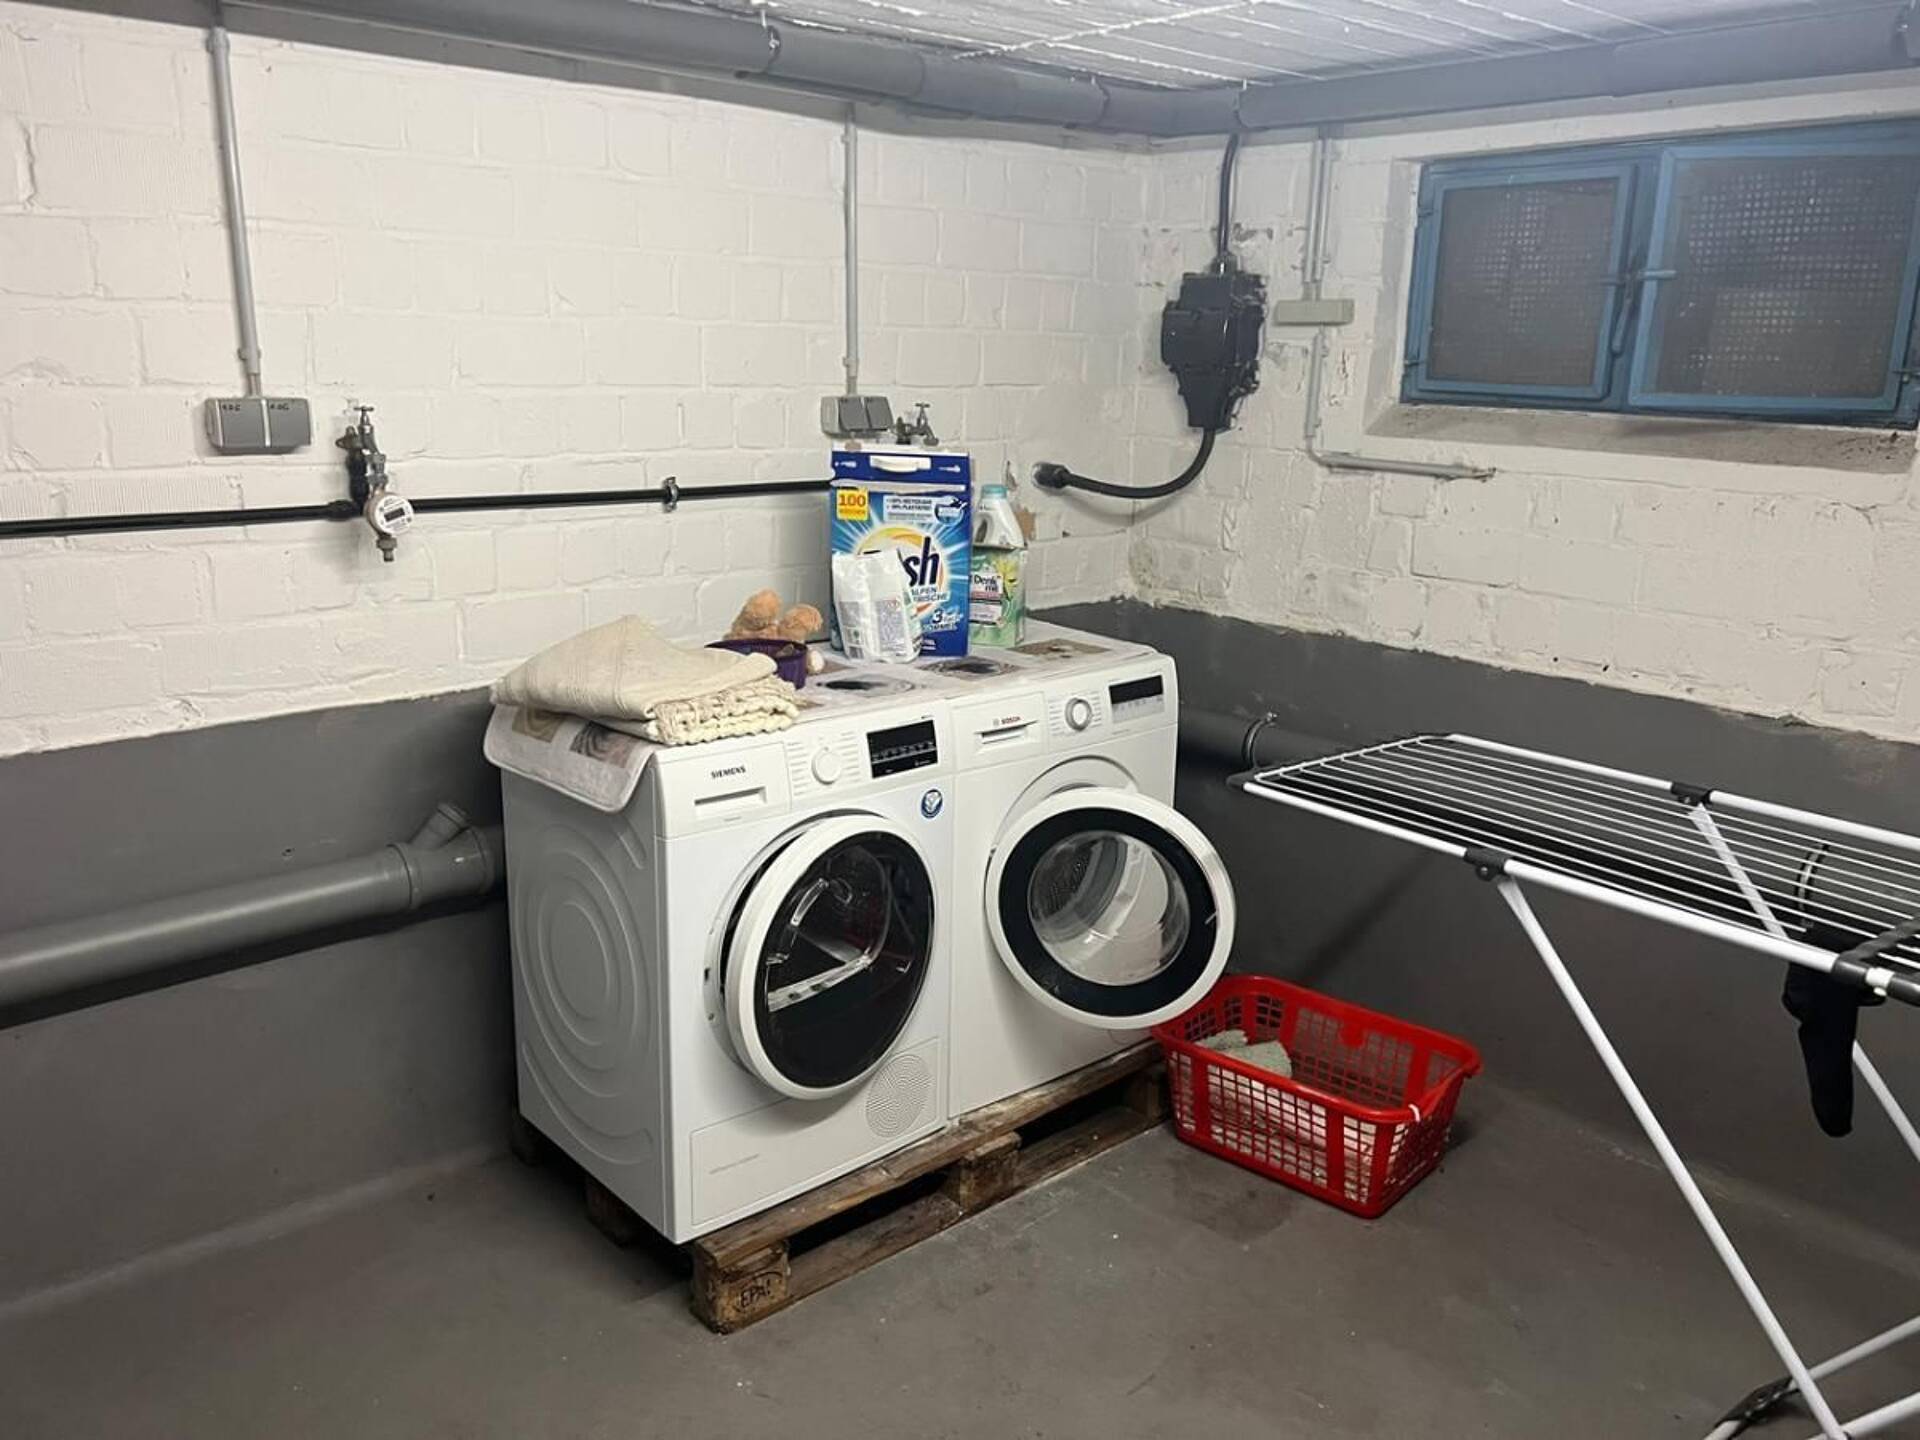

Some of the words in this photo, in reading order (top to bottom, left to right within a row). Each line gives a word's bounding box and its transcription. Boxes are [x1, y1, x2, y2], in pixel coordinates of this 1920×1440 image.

[839, 494, 866, 507] 100
[903, 536, 940, 587] sh
[711, 765, 746, 779] SIEMENS
